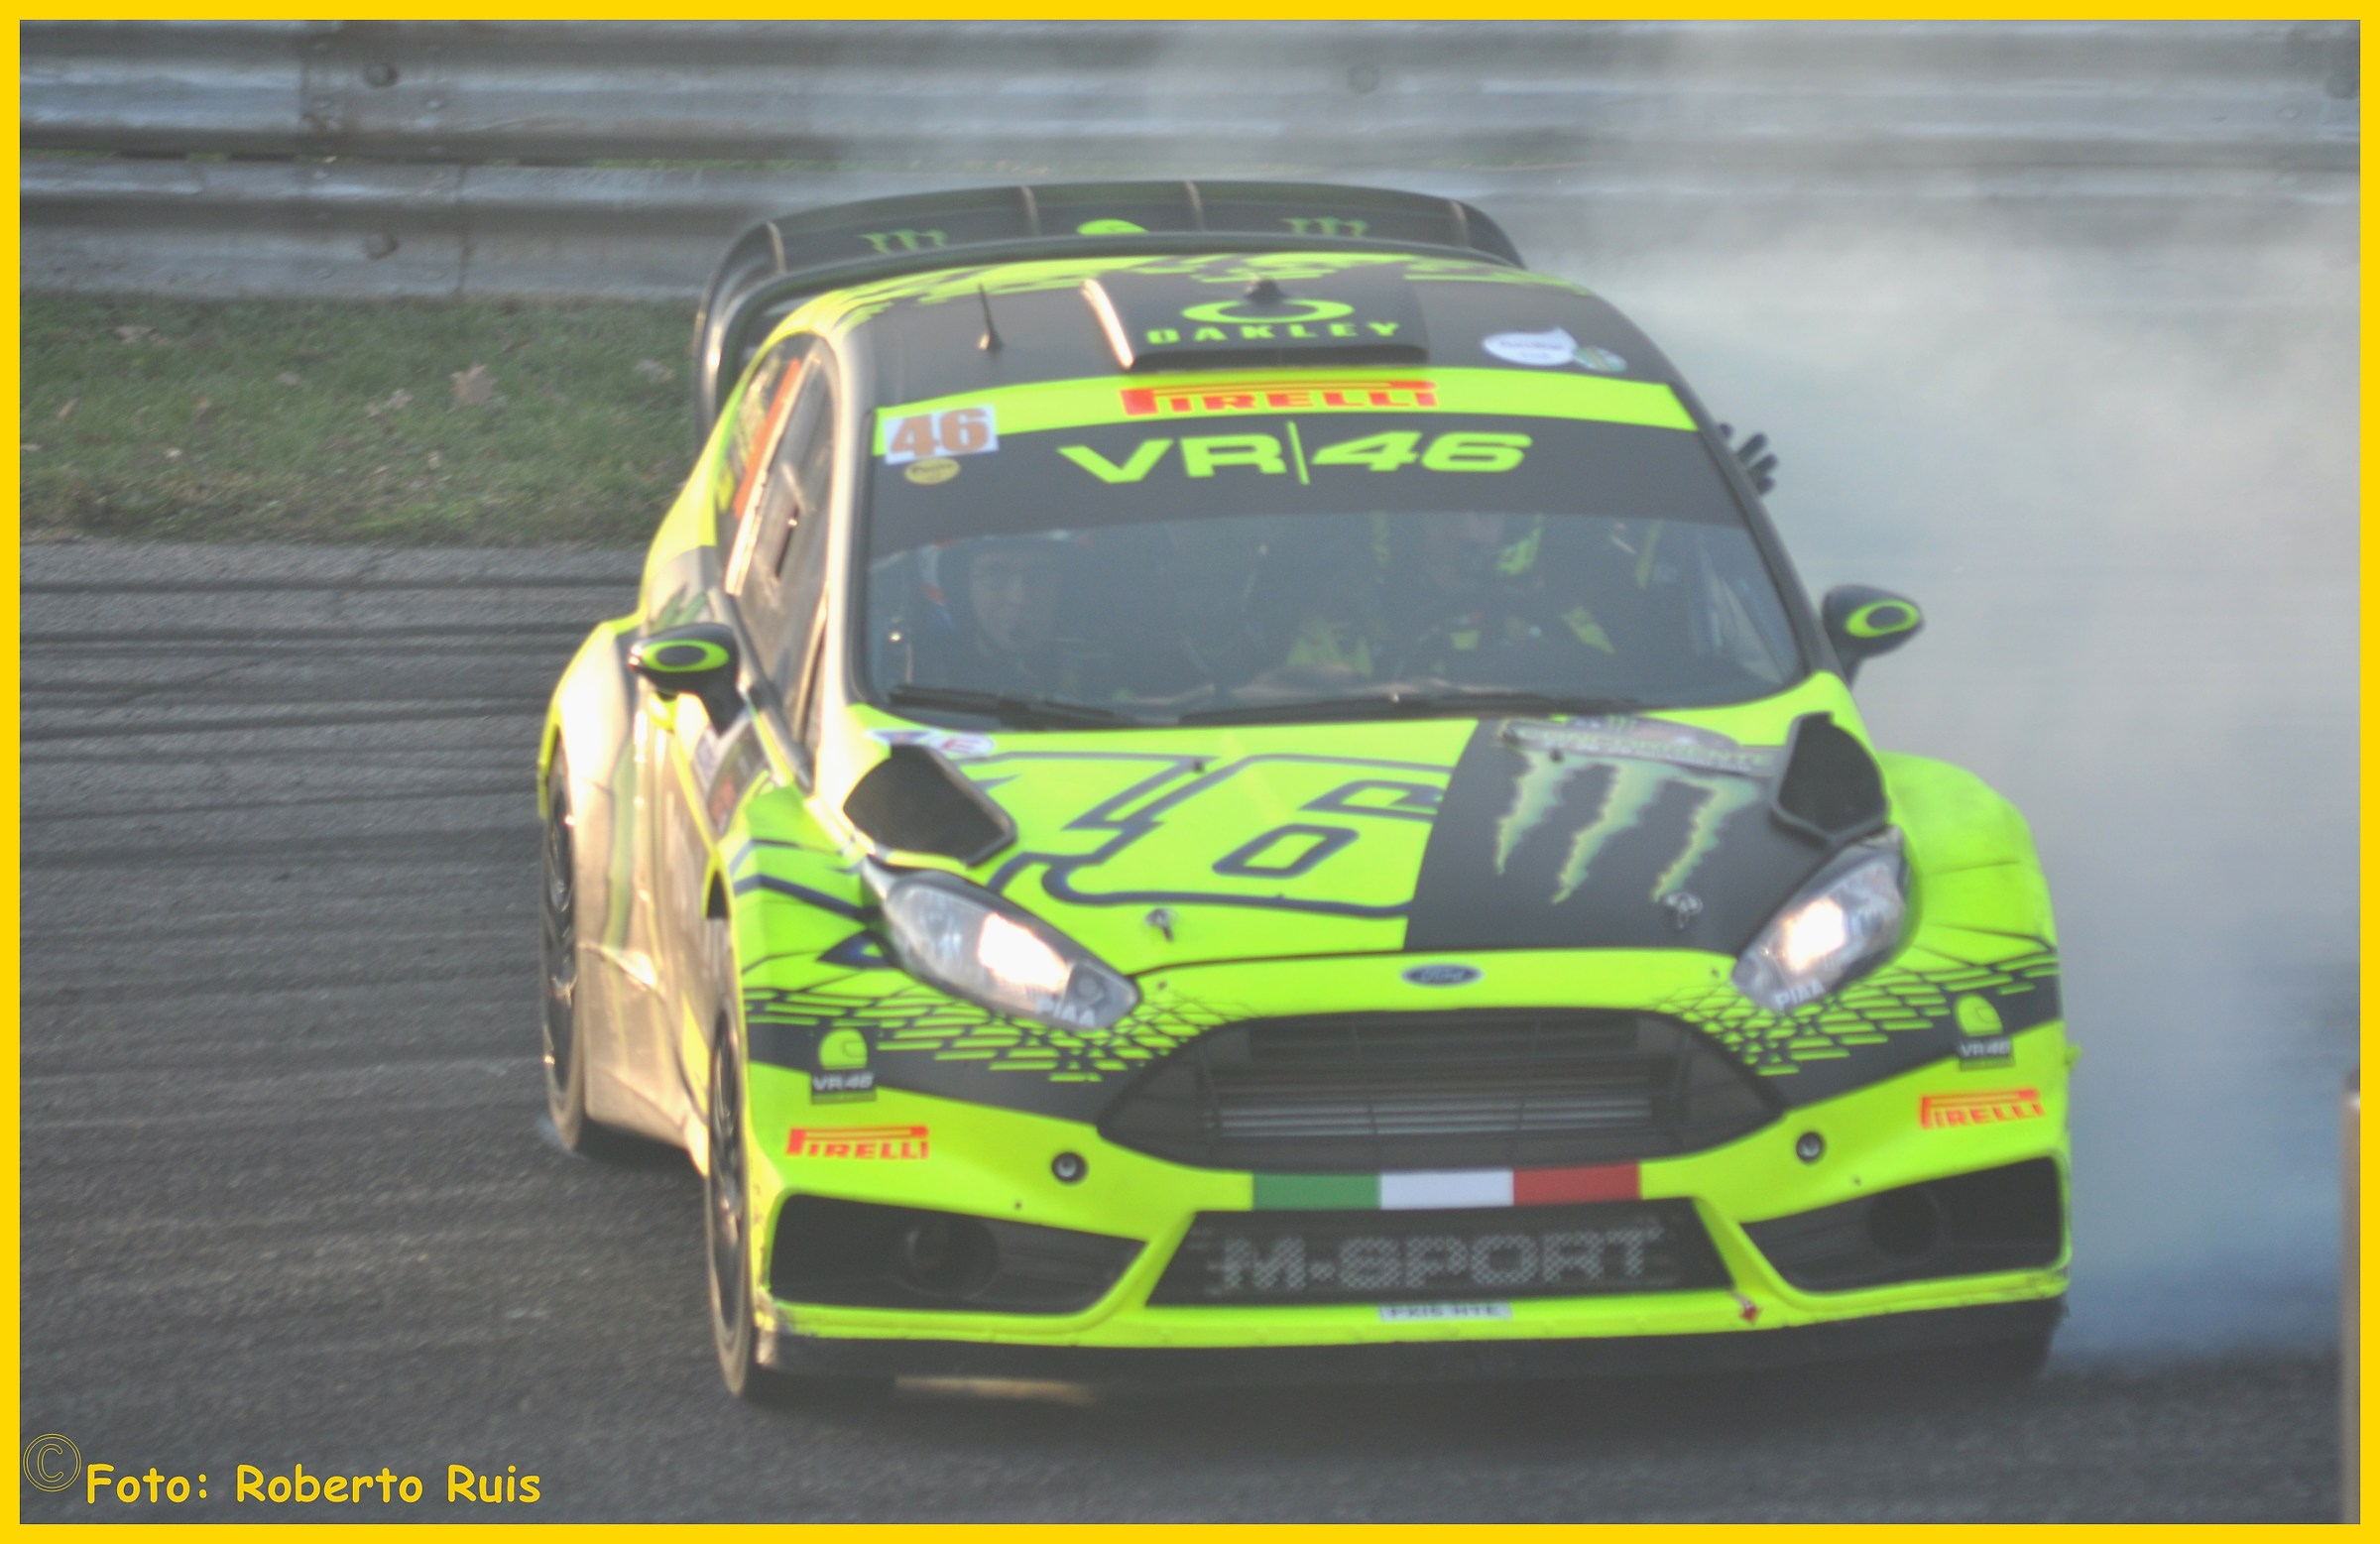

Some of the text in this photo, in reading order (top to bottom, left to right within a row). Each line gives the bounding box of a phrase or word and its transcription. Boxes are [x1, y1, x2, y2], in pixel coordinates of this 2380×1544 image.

[1146, 321, 1399, 344] OAKLEY
[1120, 380, 1437, 416] PIRELLI
[890, 408, 989, 456] 46
[1035, 998, 1096, 1027] PIAA
[1920, 1089, 2046, 1128] PIRELLI
[786, 1126, 928, 1159] PIRELLI
